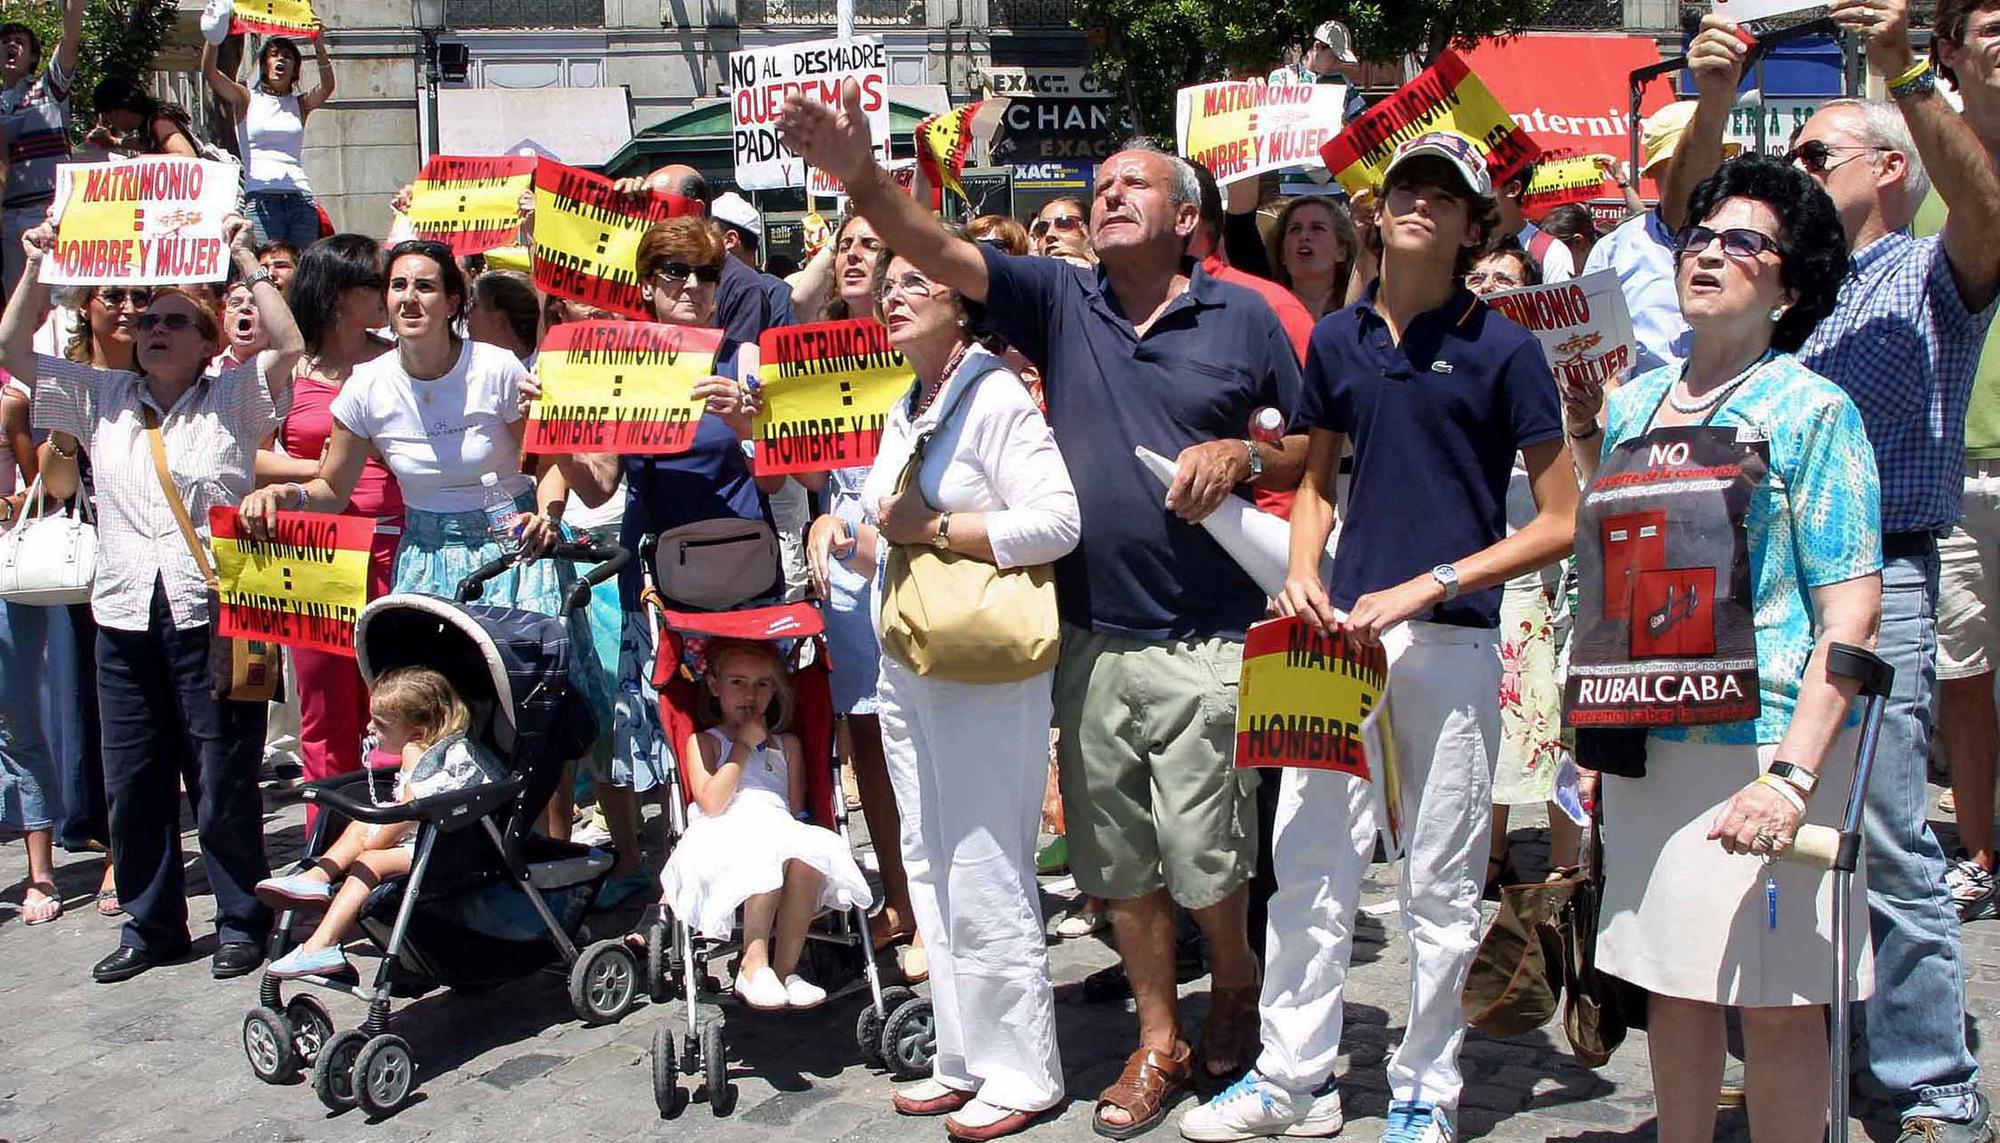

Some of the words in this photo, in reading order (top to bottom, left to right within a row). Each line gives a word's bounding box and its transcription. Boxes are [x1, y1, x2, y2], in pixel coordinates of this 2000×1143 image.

[731, 55, 756, 89] NO
[762, 56, 782, 79] AL
[794, 44, 886, 76] DESMADRE
[1203, 84, 1313, 118] MATRIMONIO
[1192, 138, 1249, 180] OMBRE
[1254, 135, 1265, 167] Y
[1269, 128, 1329, 164] MUJER
[84, 162, 204, 203] MATRIMONIO
[427, 161, 513, 190] MATRIMONIO
[781, 164, 791, 187] Y
[411, 220, 458, 246] OMBRE
[53, 239, 133, 278] HOMBRE
[139, 240, 151, 277] Y
[155, 237, 220, 277] MUJER
[534, 243, 592, 296] OMBRE
[592, 263, 609, 301] Y
[566, 327, 683, 367] MATRIMONIO
[536, 405, 610, 446] HOMBRE
[612, 407, 628, 445] Y
[626, 407, 692, 446] MUJER
[763, 416, 846, 467] HOMBRE
[850, 415, 864, 458] Y
[1648, 443, 1689, 467] NO
[227, 590, 292, 637] HOMBRE
[292, 599, 304, 640] Y
[1578, 674, 1744, 705] RUBALCABA
[1248, 713, 1360, 767] HOMBRE
